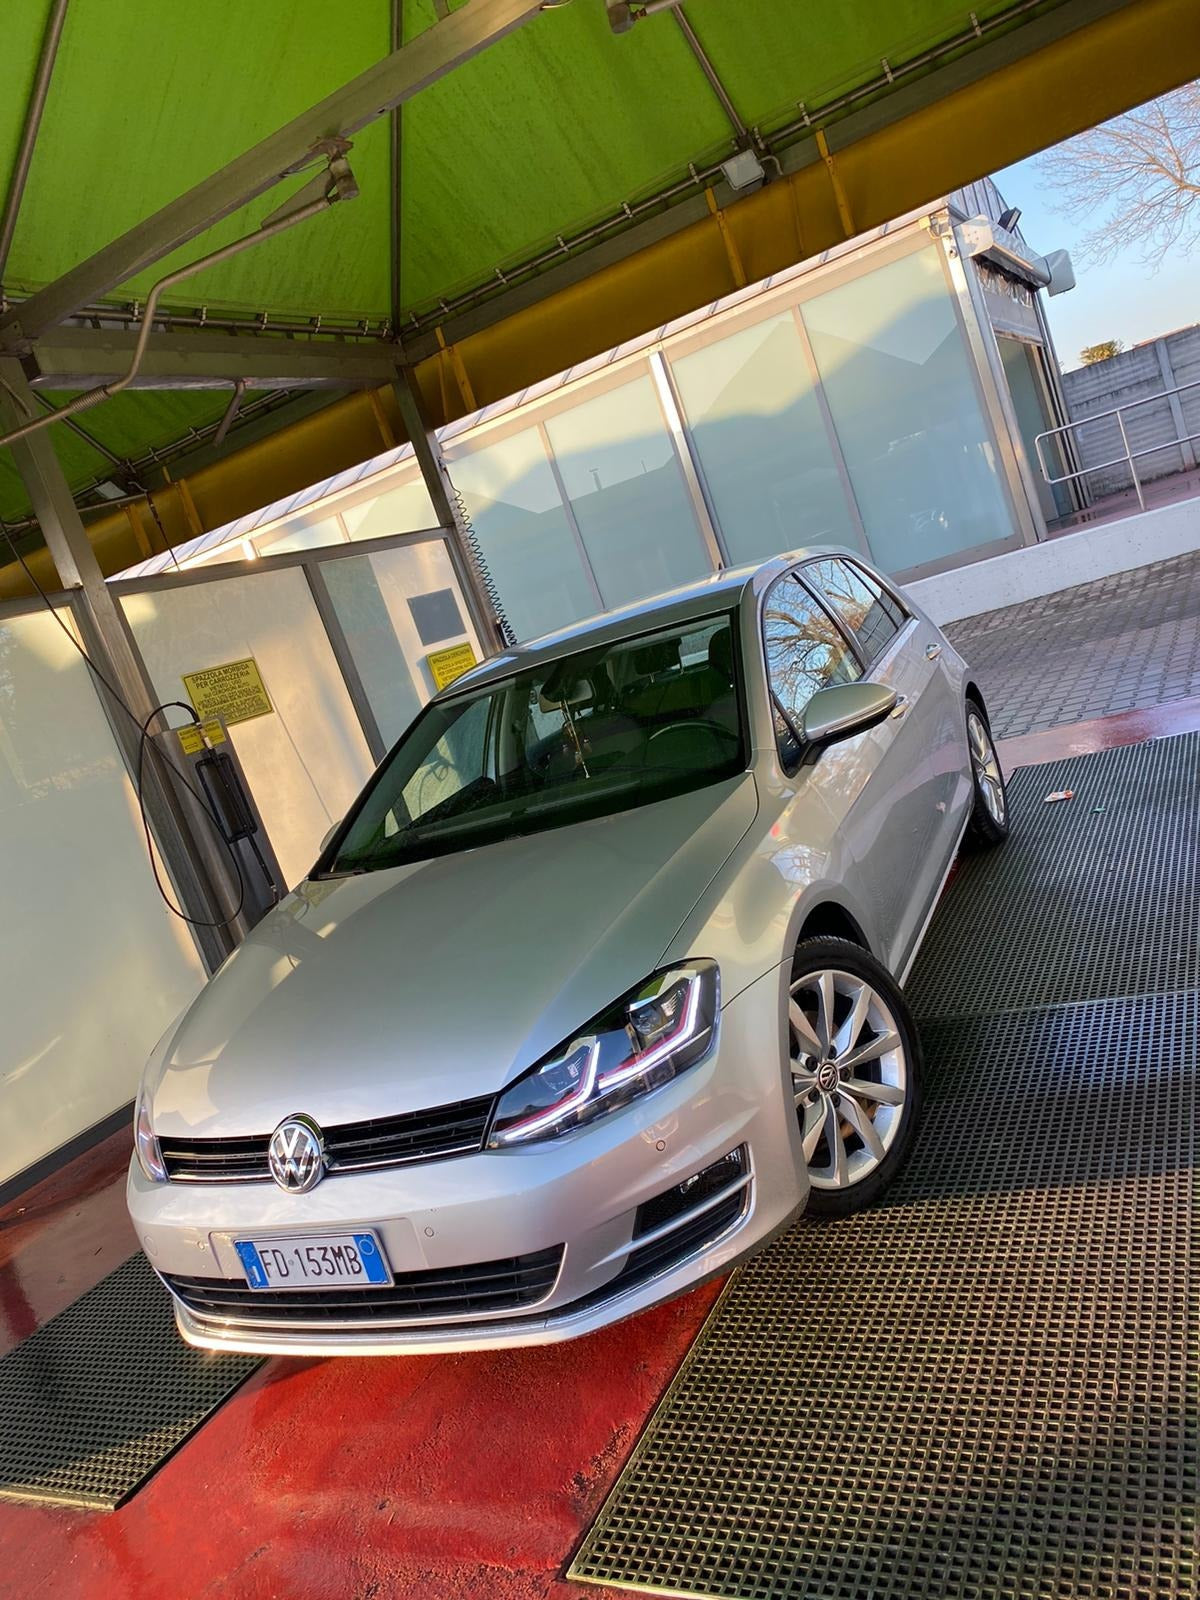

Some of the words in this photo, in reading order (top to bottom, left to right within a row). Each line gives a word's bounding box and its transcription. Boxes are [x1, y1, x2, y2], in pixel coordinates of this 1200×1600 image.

[191, 671, 222, 684] SPAZZOLA
[222, 663, 249, 673] MORBIDA
[196, 681, 209, 689] PER
[209, 670, 250, 685] CARROZZERIA
[259, 1249, 289, 1278] FD
[294, 1245, 362, 1277] 153MB
